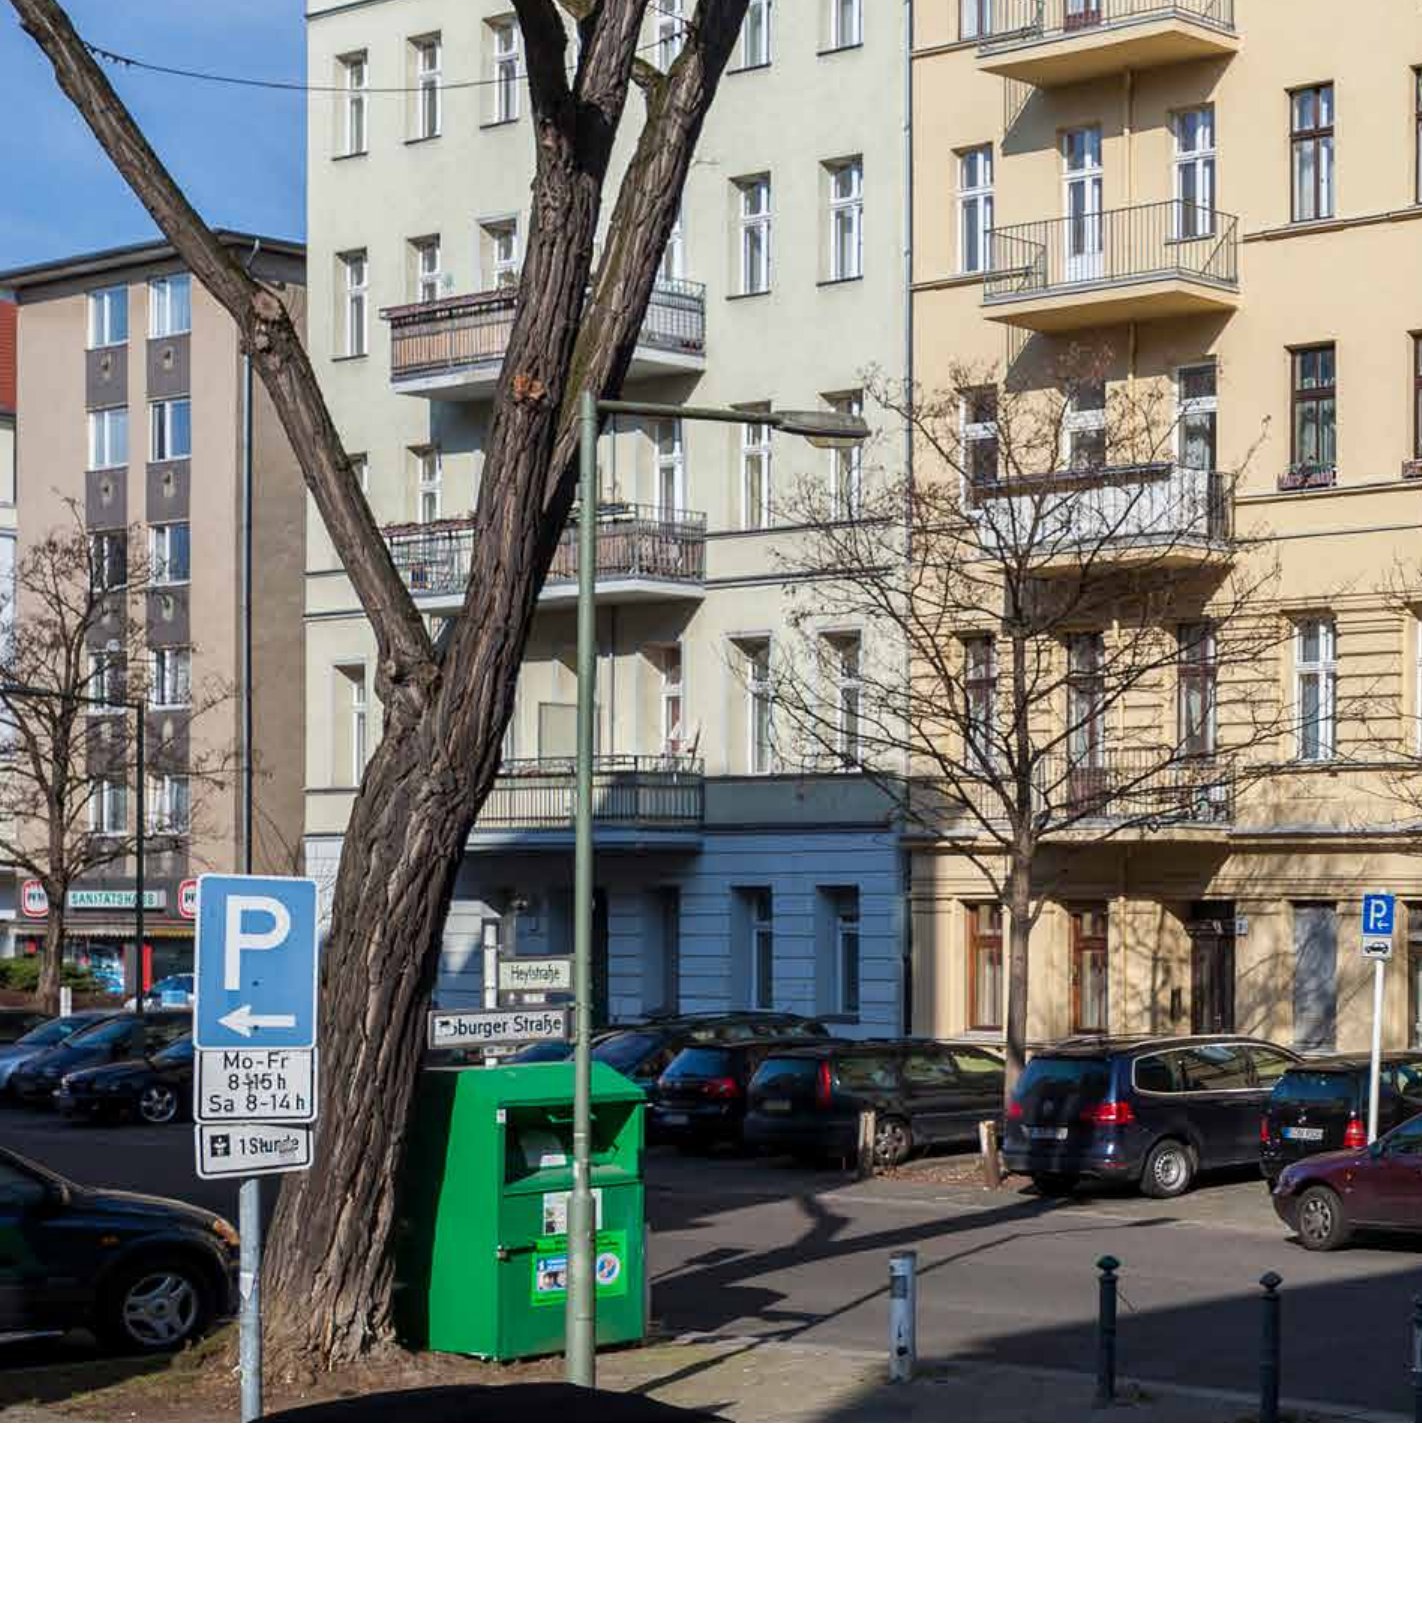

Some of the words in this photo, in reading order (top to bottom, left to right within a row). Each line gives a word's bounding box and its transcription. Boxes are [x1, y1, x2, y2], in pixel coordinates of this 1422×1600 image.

[1370, 899, 1387, 930] P
[224, 895, 291, 990] P
[514, 1014, 562, 1034] Straße
[278, 1073, 287, 1090] h
[209, 1094, 235, 1112] Sa
[296, 1093, 306, 1110] h
